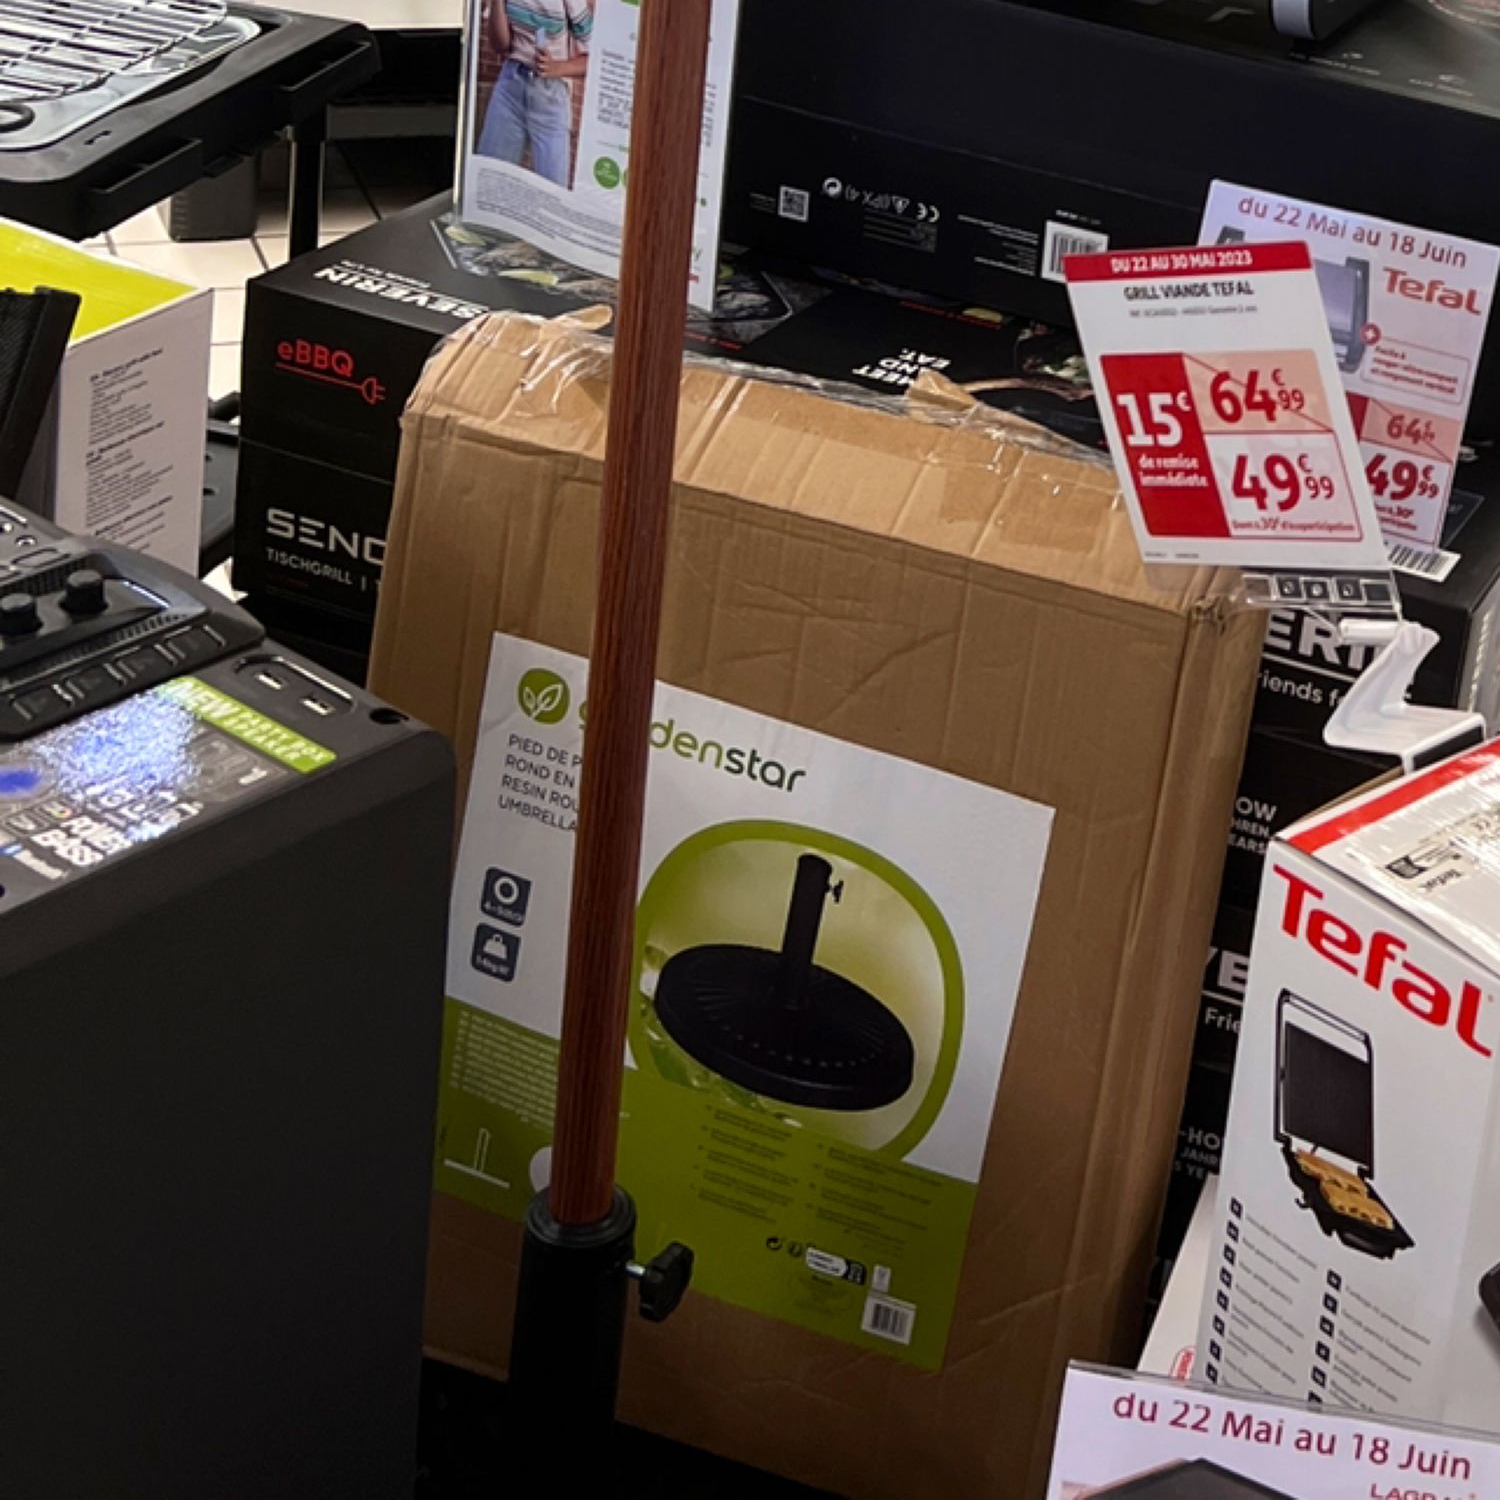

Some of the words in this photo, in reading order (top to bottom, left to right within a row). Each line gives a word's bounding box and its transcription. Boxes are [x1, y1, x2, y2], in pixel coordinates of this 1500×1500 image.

[1238, 196, 1267, 220] du
[1273, 205, 1301, 228] 22
[1306, 215, 1346, 239] Mai
[1352, 227, 1381, 246] au
[1390, 232, 1413, 254] 18
[1418, 239, 1467, 269] Juin
[1110, 256, 1130, 273] DU
[1132, 255, 1148, 272] 22
[1150, 254, 1169, 270] AU
[1170, 254, 1187, 269] 30
[1189, 252, 1215, 268] MAI
[1217, 249, 1252, 266] 2023
[1123, 285, 1159, 301] GRILL
[1160, 282, 1210, 299] VIANDE
[1212, 280, 1254, 295] TEFAL
[1383, 266, 1482, 316] Tefal
[278, 339, 354, 376] eBBQ
[1139, 455, 1152, 469] de
[1154, 454, 1199, 470] remise
[1139, 471, 1208, 487] immédiate
[266, 547, 353, 584] TISCHGRILL
[1262, 673, 1323, 705] iends
[508, 733, 543, 757] PIED
[546, 746, 568, 764] DE
[501, 774, 546, 799] RESIN
[504, 755, 550, 780] ROND
[553, 771, 575, 789] EN
[498, 795, 577, 833] UMBRELLA
[1273, 862, 1493, 1059] Tefal
[1113, 1393, 1158, 1423] du
[1169, 1401, 1208, 1433] 22
[1221, 1408, 1284, 1447] Mai
[1294, 1428, 1336, 1456] au
[1352, 1433, 1390, 1465] 18
[1398, 1443, 1471, 1481] Juin
